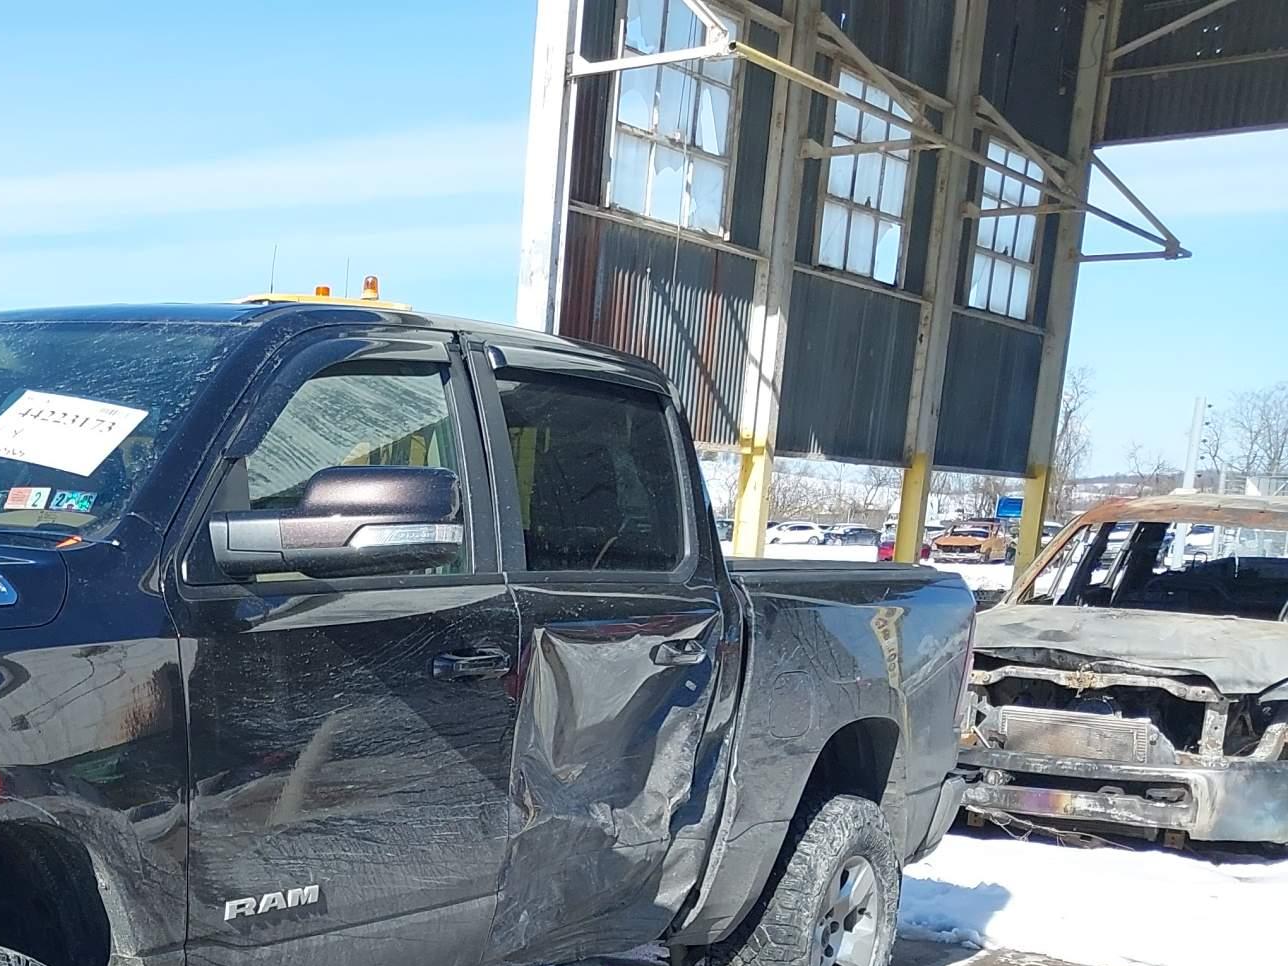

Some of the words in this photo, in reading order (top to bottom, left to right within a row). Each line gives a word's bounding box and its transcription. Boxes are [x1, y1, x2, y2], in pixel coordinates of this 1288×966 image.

[18, 407, 116, 432] 44223173
[32, 491, 42, 507] 2
[224, 884, 319, 920] RAM
